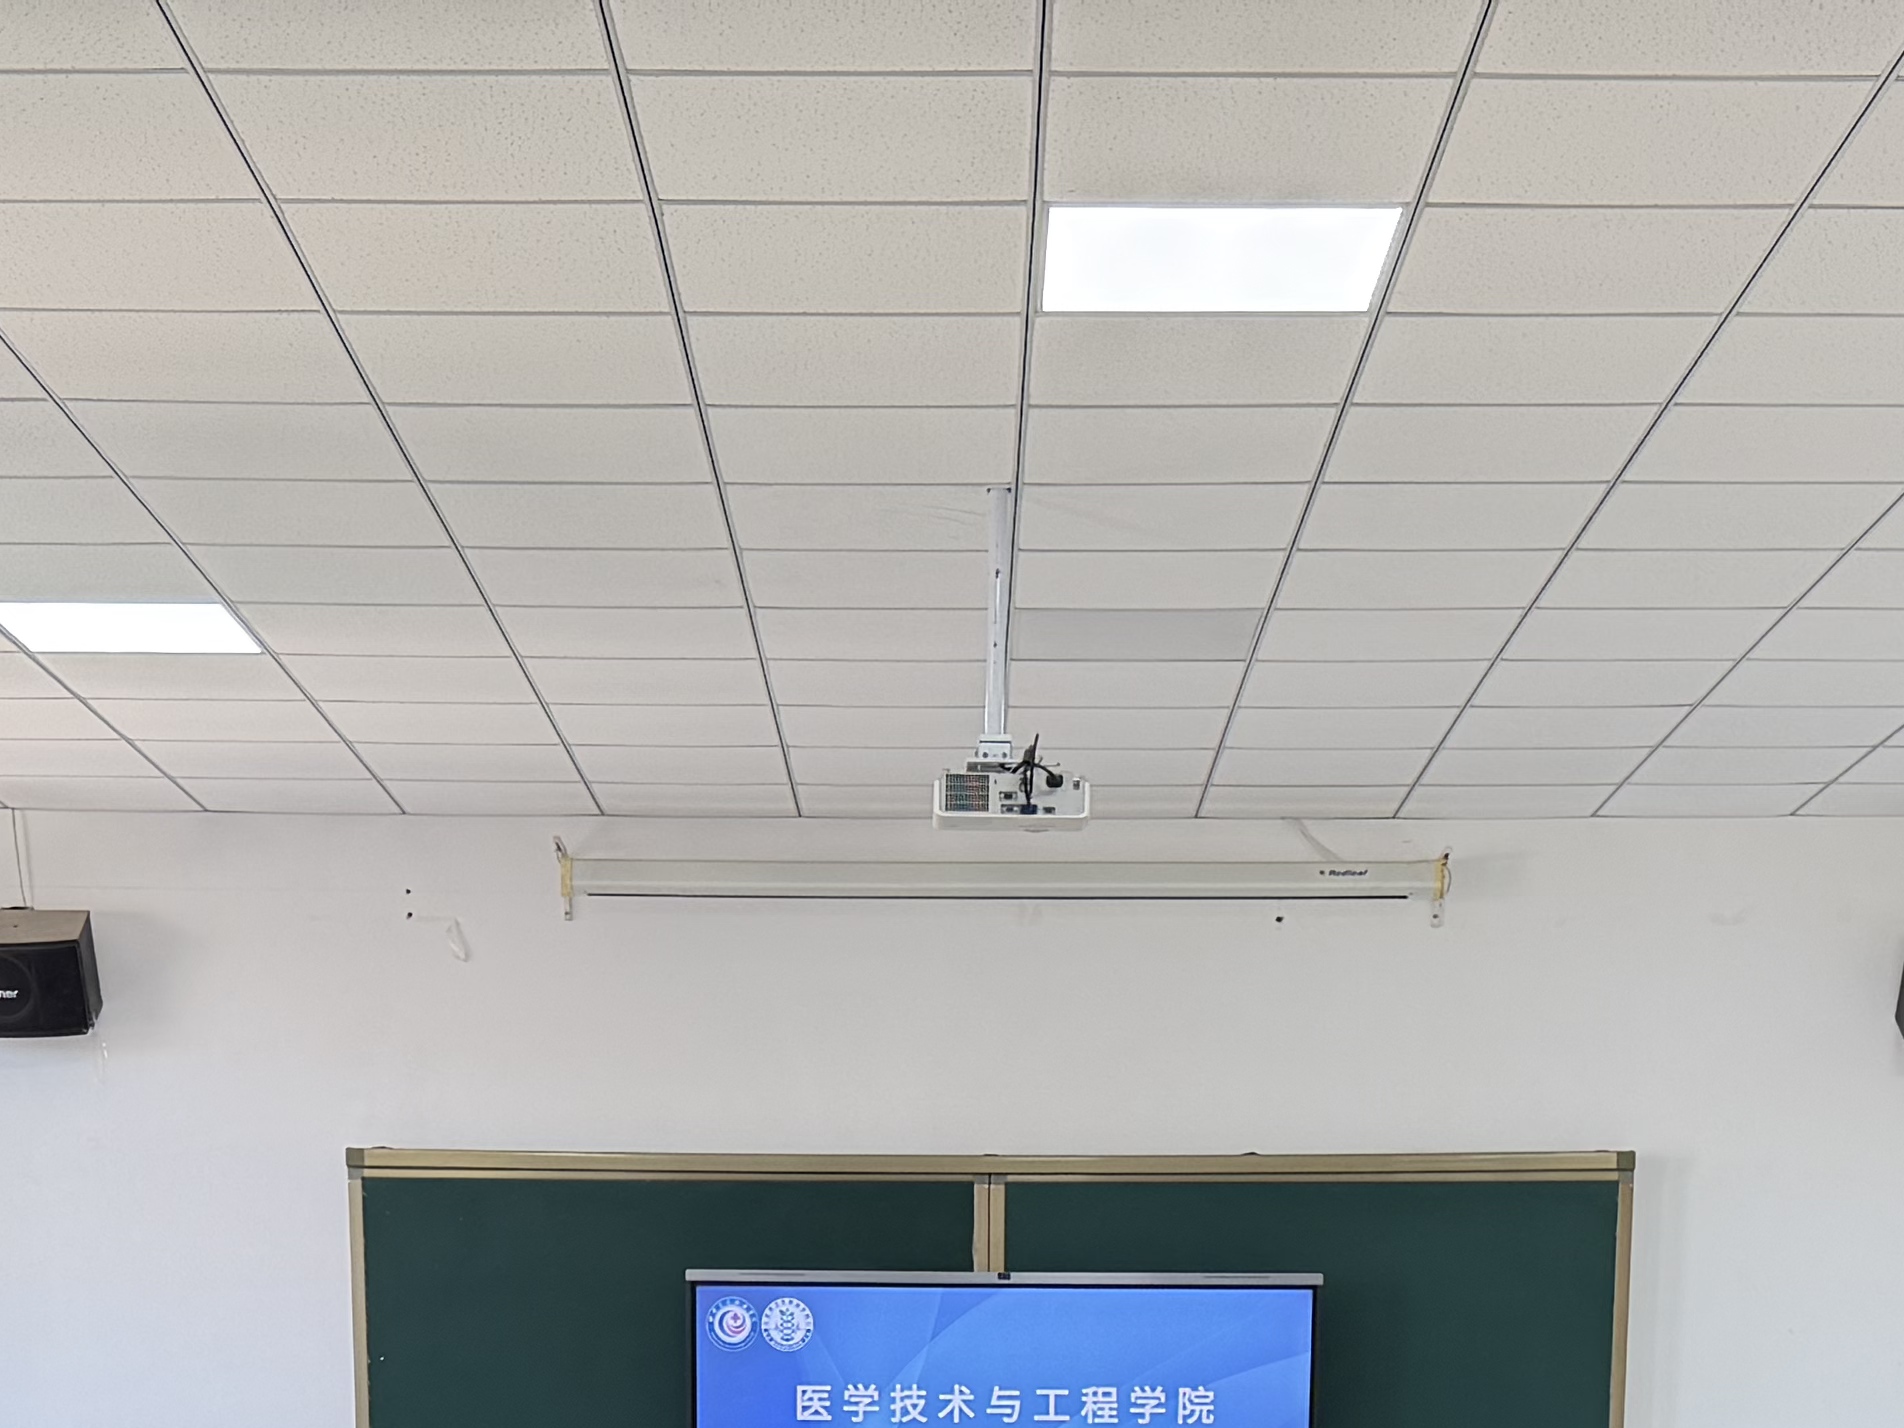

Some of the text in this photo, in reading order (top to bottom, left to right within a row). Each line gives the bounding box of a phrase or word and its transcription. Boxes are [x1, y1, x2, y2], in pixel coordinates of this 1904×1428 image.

[795, 1384, 1216, 1426] 医学技术与工程学院
